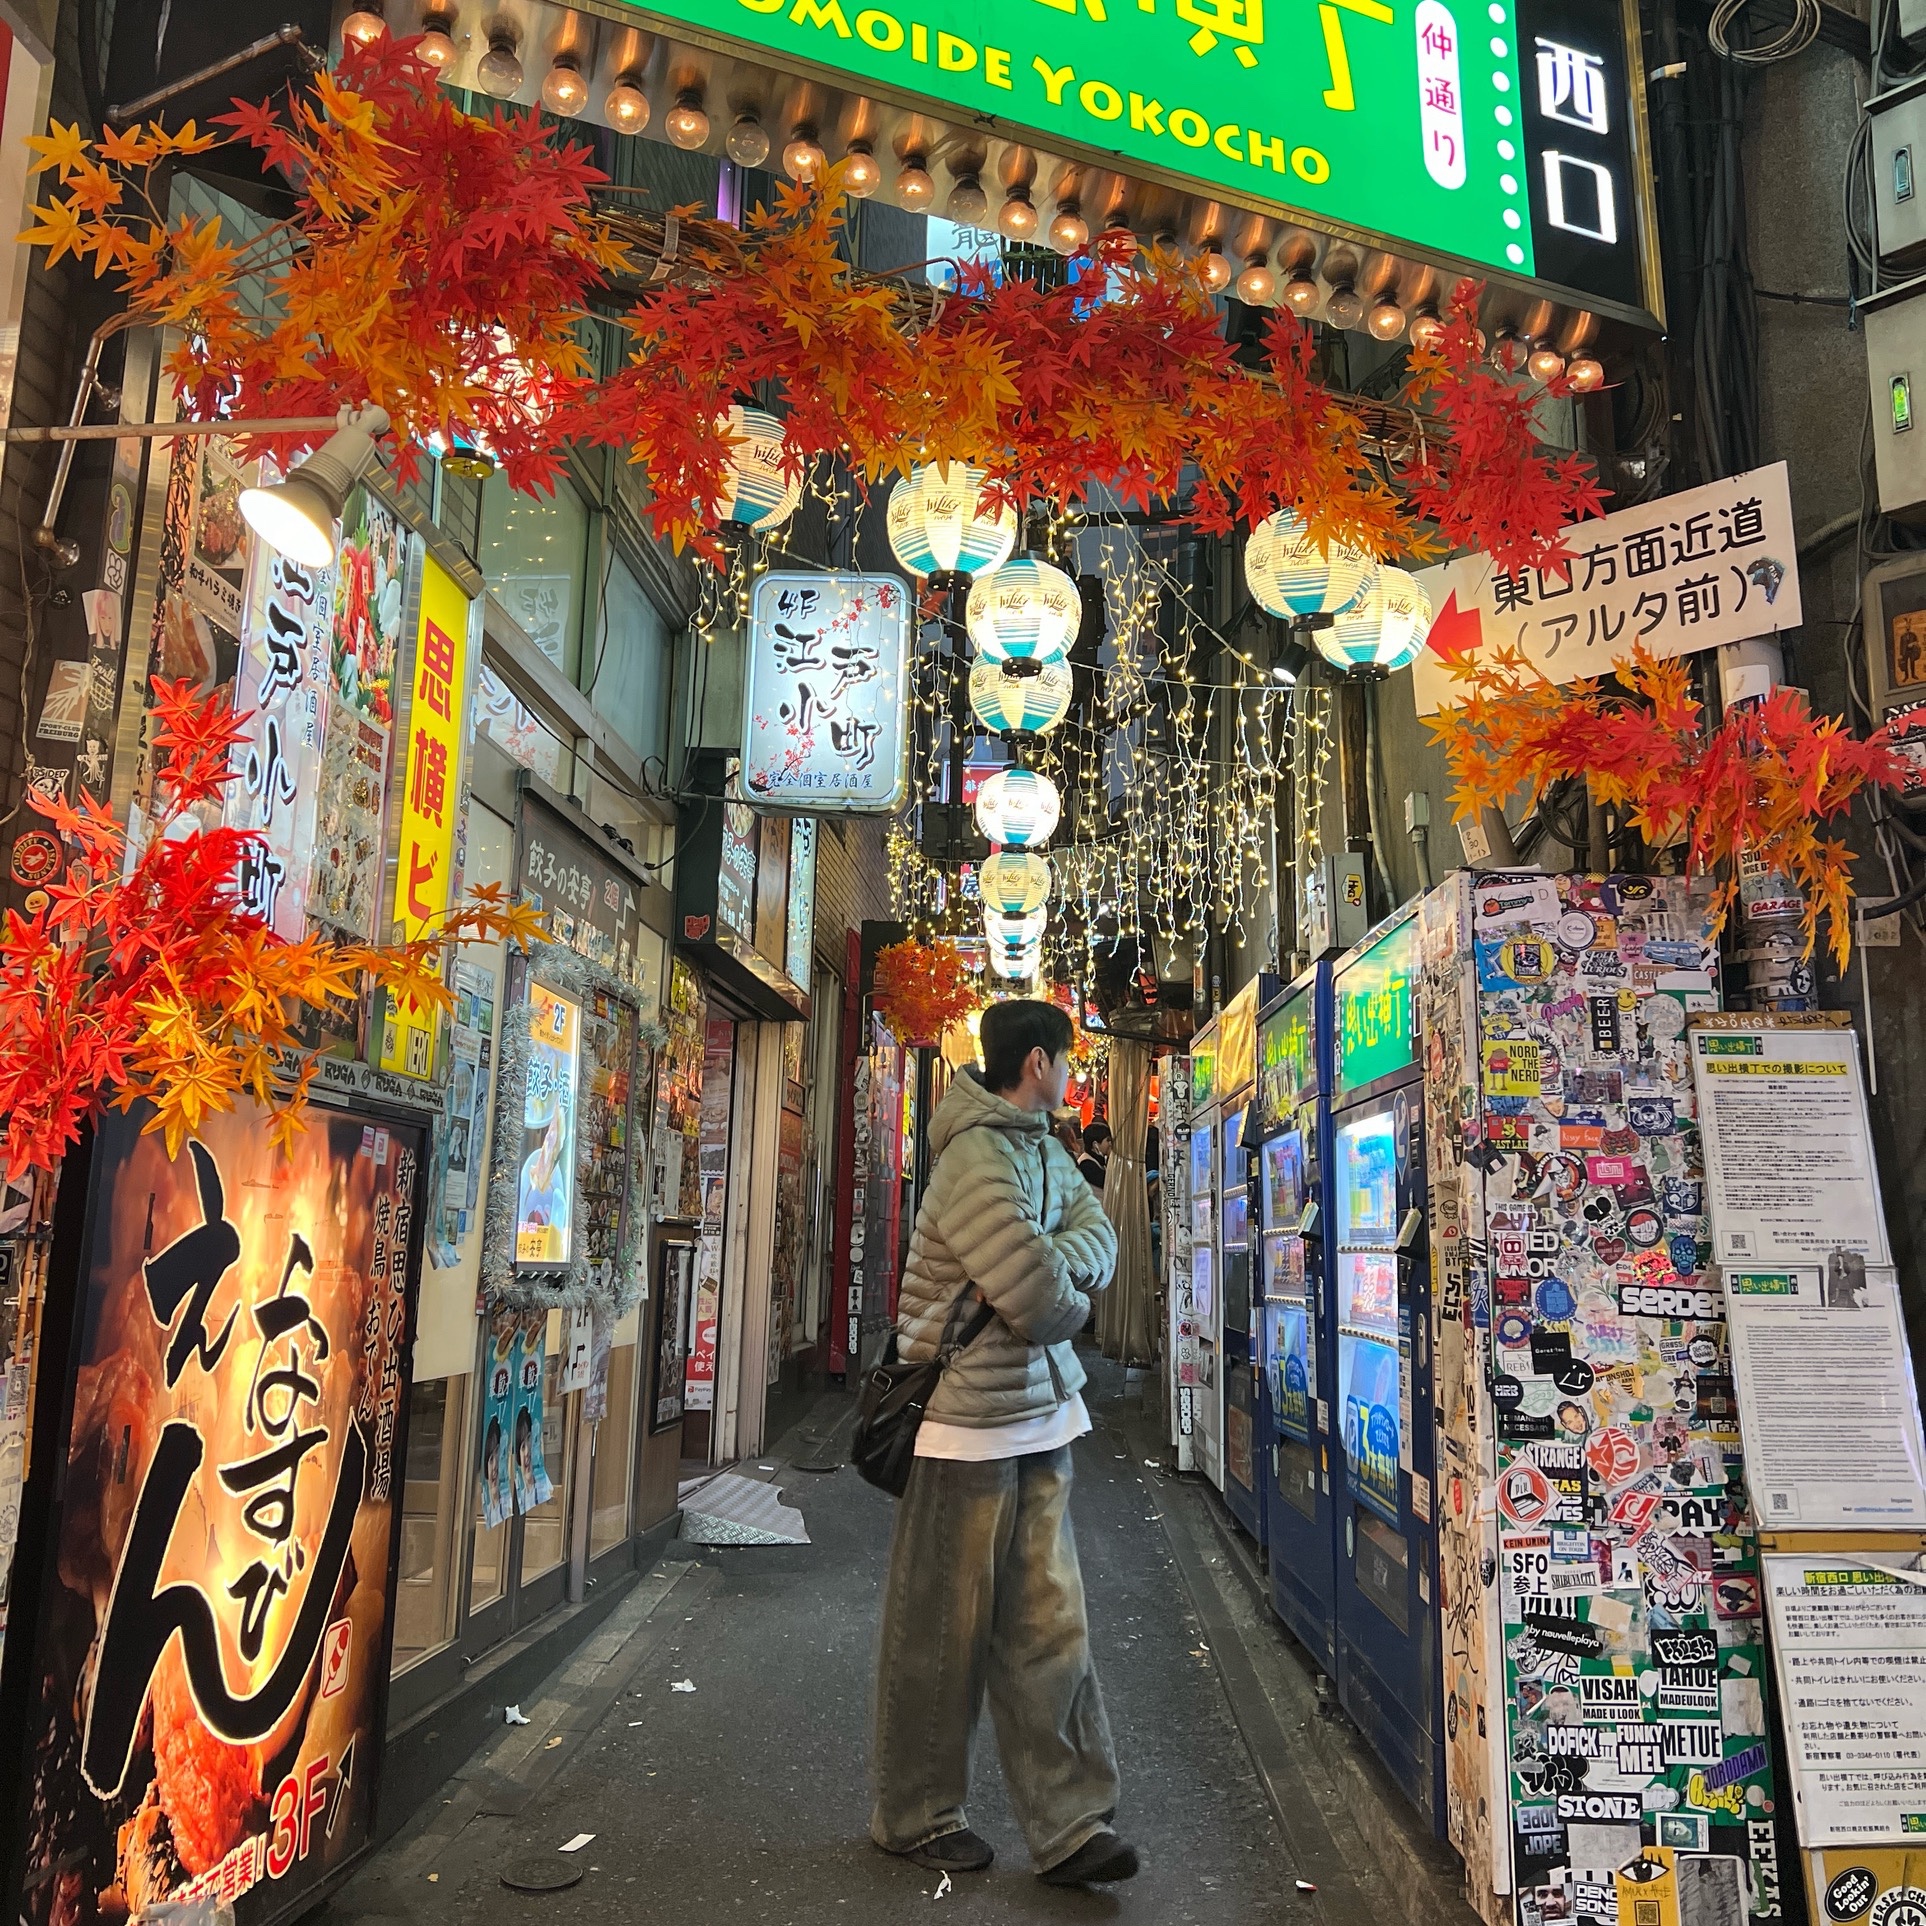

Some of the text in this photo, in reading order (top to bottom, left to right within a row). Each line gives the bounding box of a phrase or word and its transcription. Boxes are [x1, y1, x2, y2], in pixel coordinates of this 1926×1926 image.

[1421, 21, 1458, 168] 仲通り
[1032, 55, 1331, 185] YOKOCHO
[1535, 37, 1617, 245] 西口
[1490, 496, 1768, 615] 東口方面近道
[777, 587, 820, 619] 4F
[772, 622, 882, 771] 江戸小町
[39, 729, 79, 738] FREIBURG
[768, 771, 873, 788] 完全個室居酒屋
[528, 840, 592, 911] 餃子の安亭
[1751, 900, 1800, 913] GARAGE
[1597, 998, 1612, 1038] BEER
[1510, 1046, 1538, 1058] NORD
[1522, 1059, 1539, 1069] THE
[1706, 1062, 1847, 1074] 思い出横丁での撮影について
[1511, 1070, 1539, 1082] NERD
[1495, 1203, 1508, 1211] THIS
[1503, 1539, 1524, 1550] KEIN
[1513, 1553, 1549, 1574] SFO
[1513, 1575, 1549, 1595] 参上
[1530, 1624, 1540, 1637] by
[1582, 1678, 1639, 1702] VISAH
[1582, 1708, 1641, 1720] MADE U LOOK
[1616, 1724, 1664, 1744] FUNKY
[1619, 1744, 1665, 1774] MEL
[266, 1755, 330, 1880] 3F
[1557, 1794, 1642, 1820] STONE
[1833, 1873, 1859, 1899] Good
[1835, 1875, 1870, 1912] Lookin'
[1849, 1894, 1869, 1913] Out
